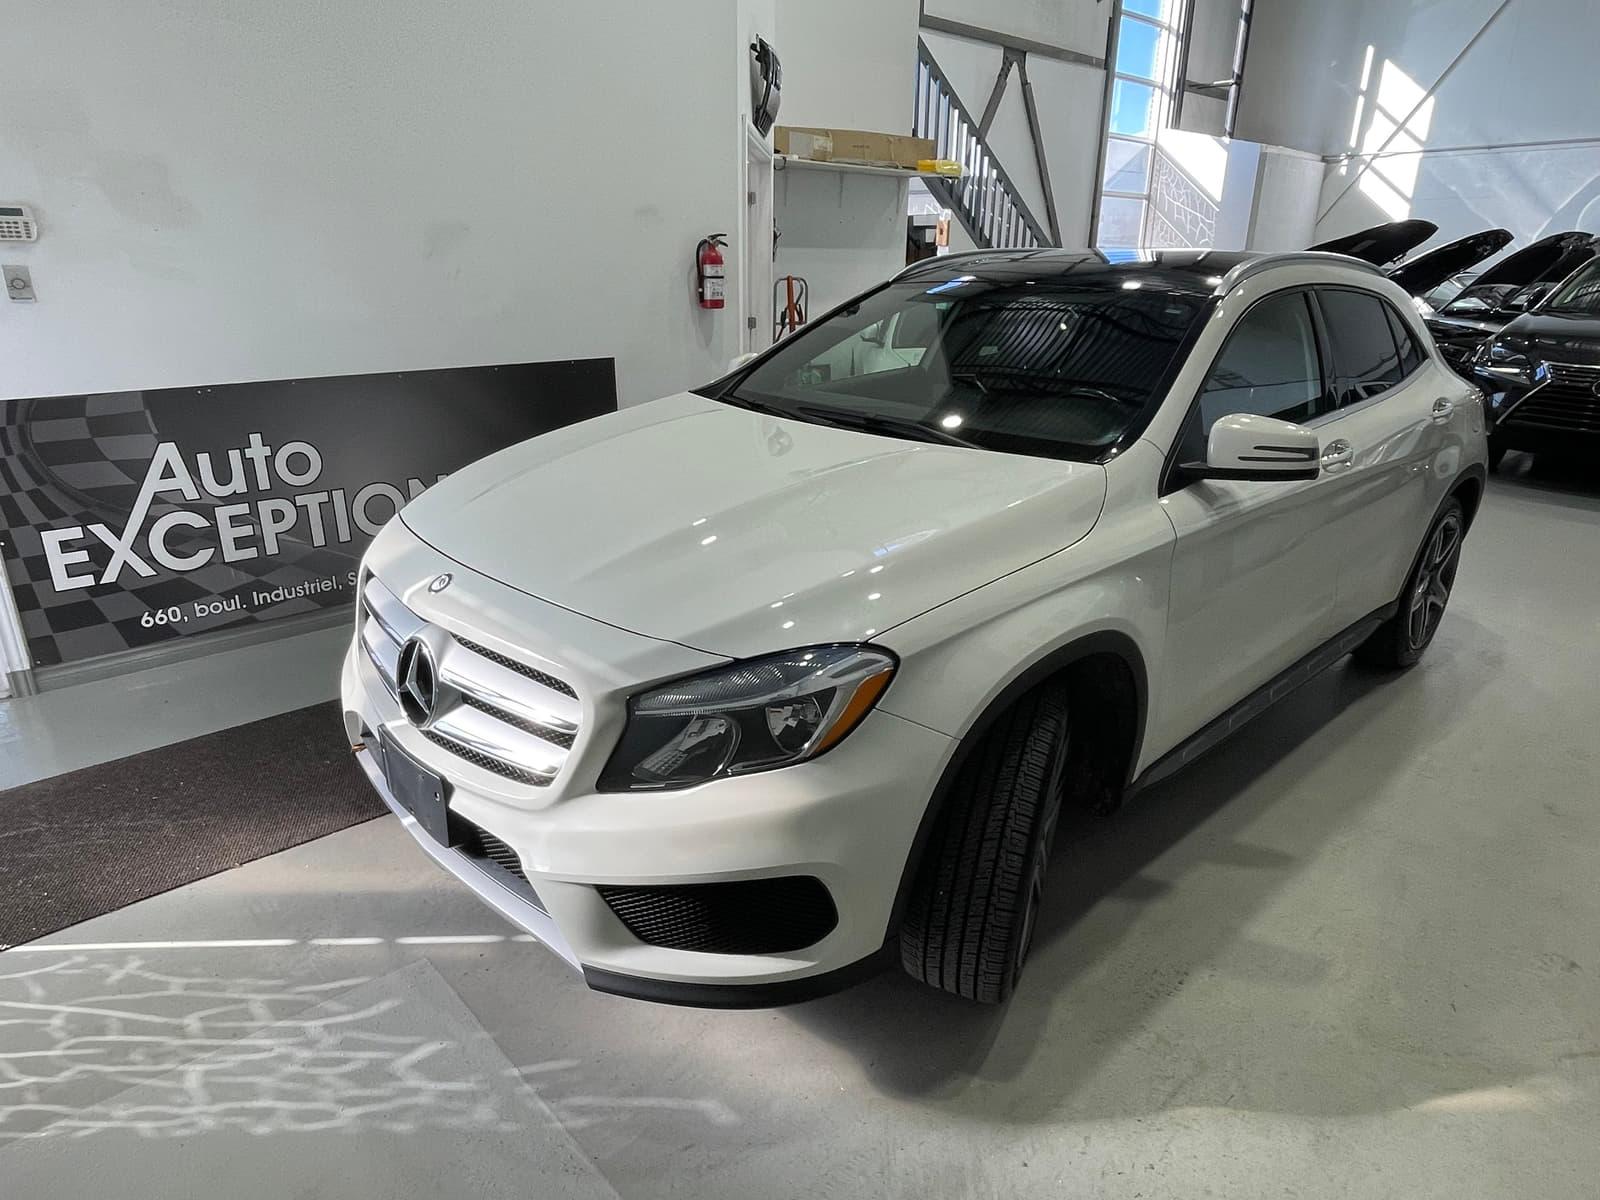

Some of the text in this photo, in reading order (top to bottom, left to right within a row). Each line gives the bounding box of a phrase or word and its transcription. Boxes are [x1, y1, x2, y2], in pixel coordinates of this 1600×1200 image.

[136, 432, 323, 500] Auto
[141, 605, 189, 628] 660,
[194, 595, 247, 617] boul.
[252, 575, 343, 606] Industriel,
